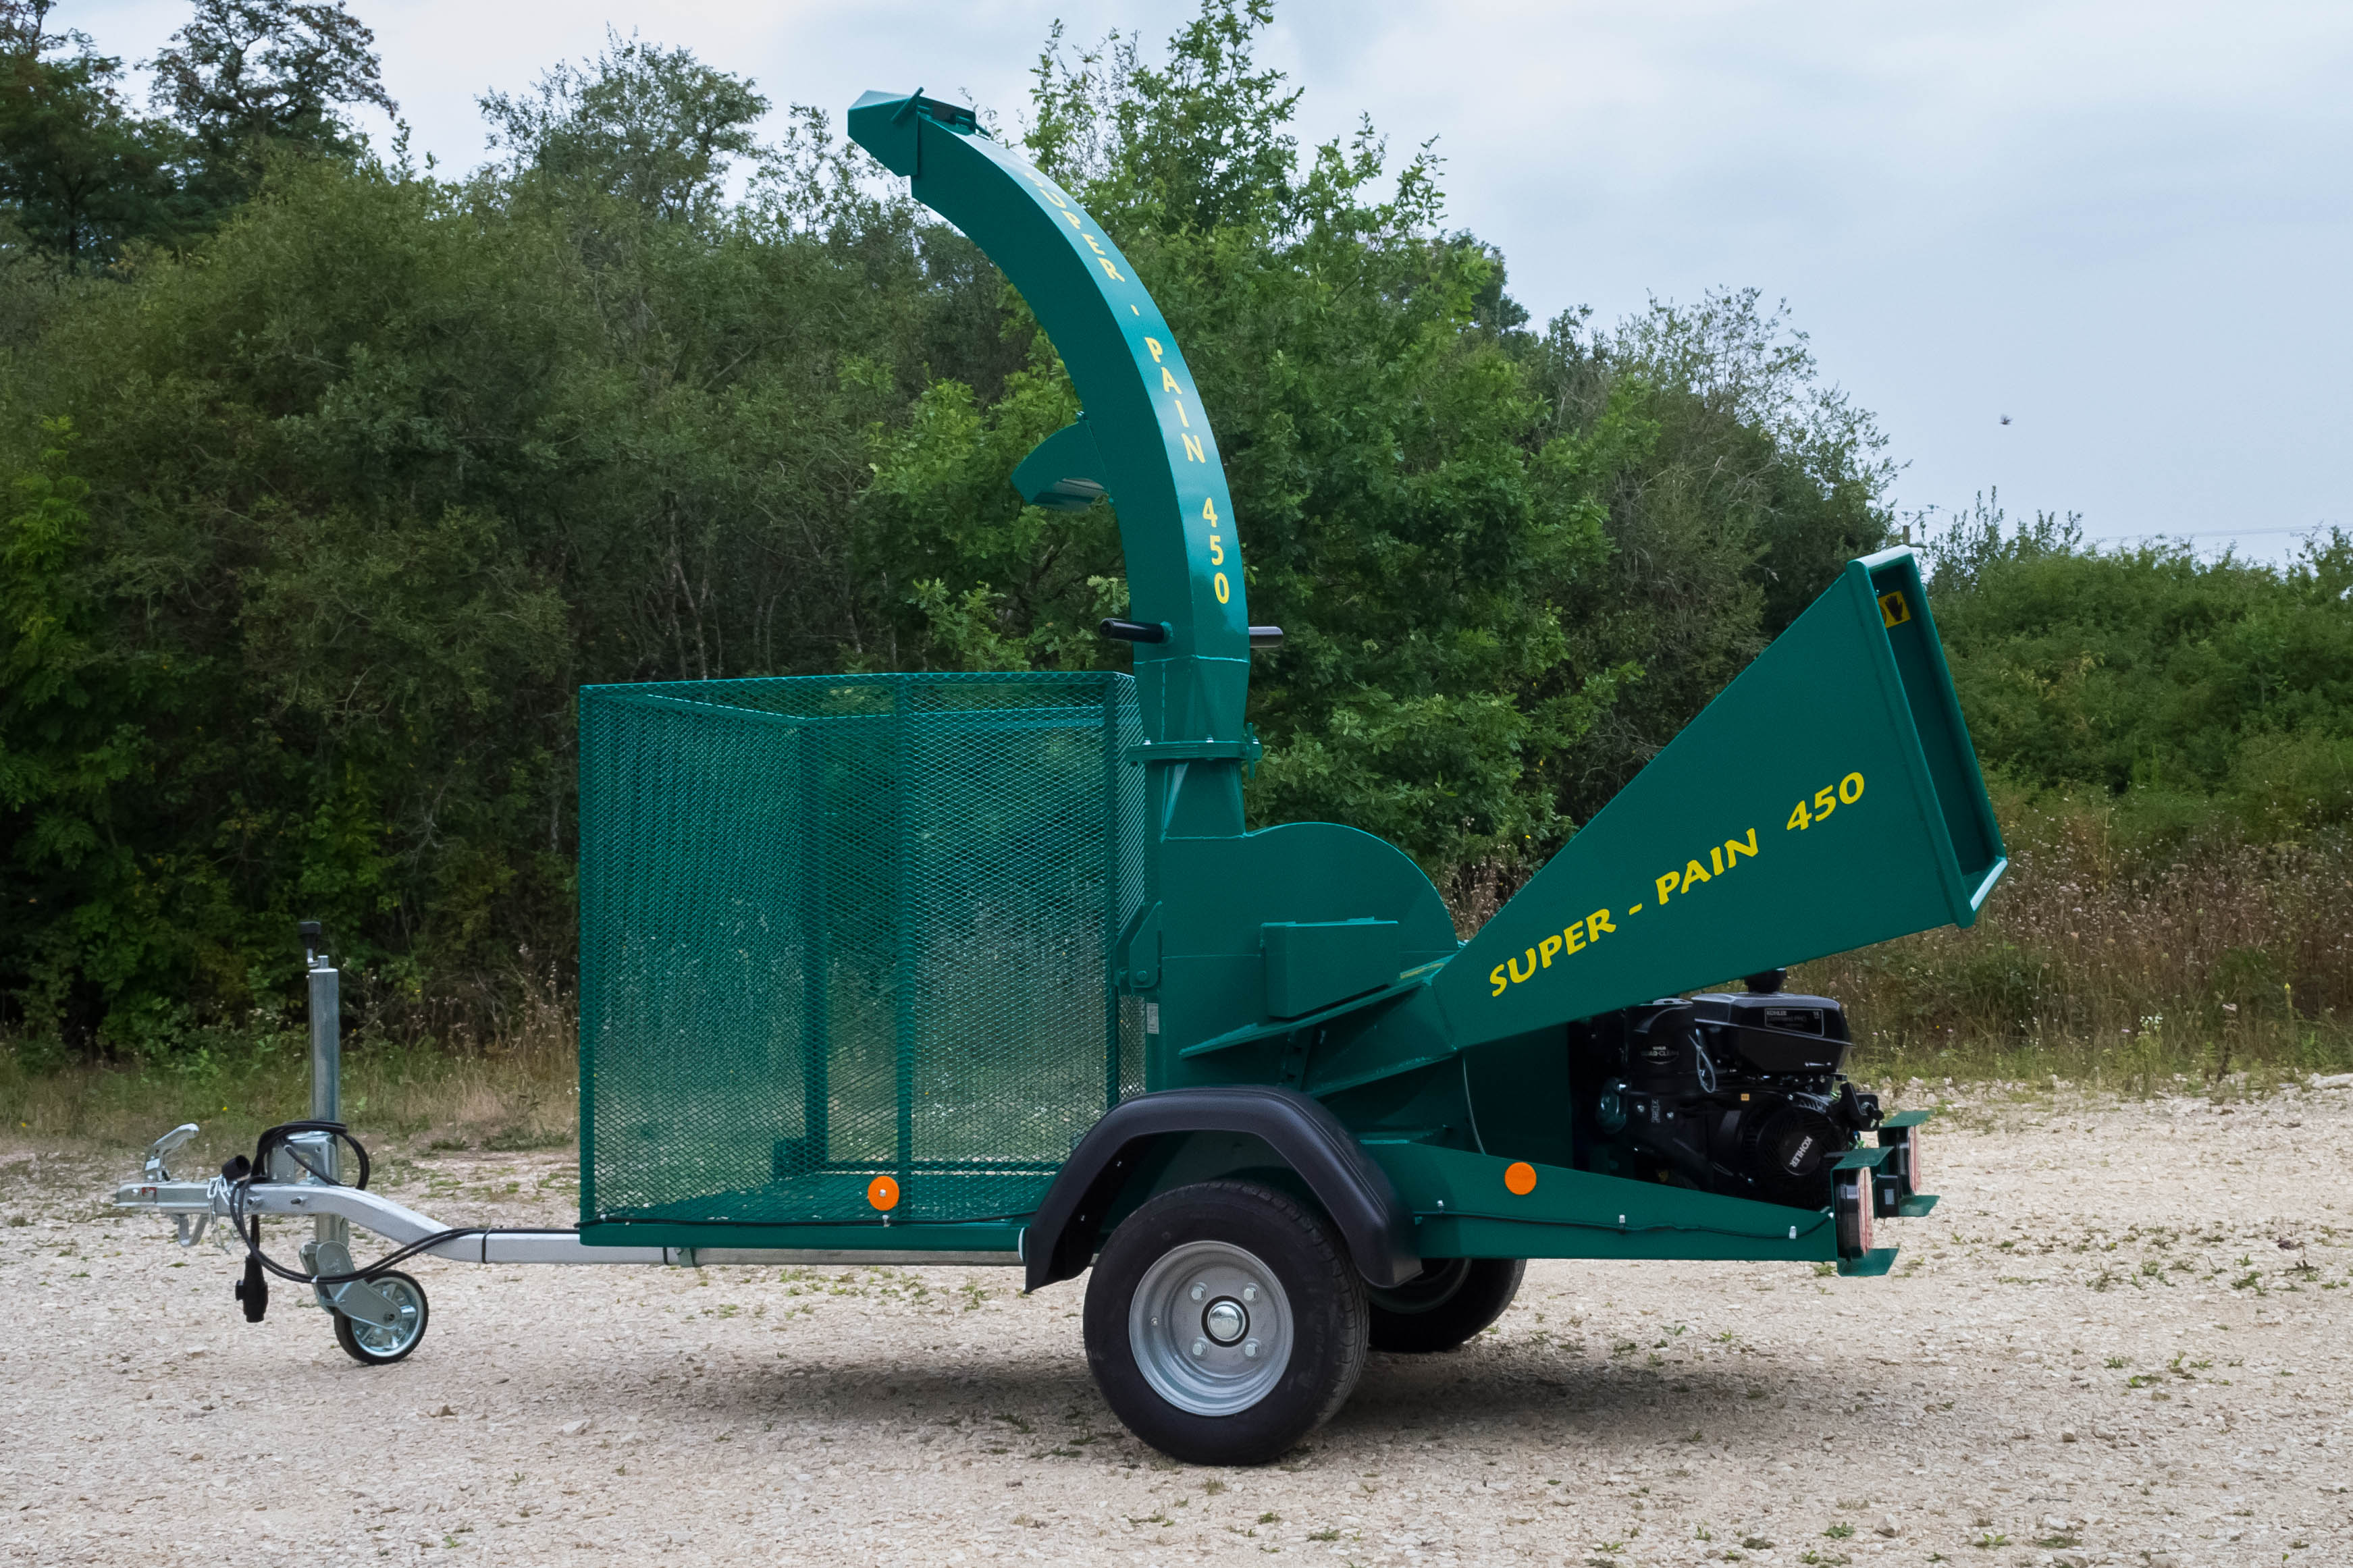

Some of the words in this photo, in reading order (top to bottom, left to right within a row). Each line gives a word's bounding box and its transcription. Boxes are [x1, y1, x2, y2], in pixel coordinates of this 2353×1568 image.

[1024, 173, 1126, 283] SUPER
[1144, 337, 1206, 464] PAIN
[1202, 497, 1230, 604] 450
[1489, 909, 1616, 997] SUPER
[1656, 828, 1759, 905] PAIN
[1787, 772, 1865, 830] 450
[1790, 1135, 1813, 1168] KOHLER
